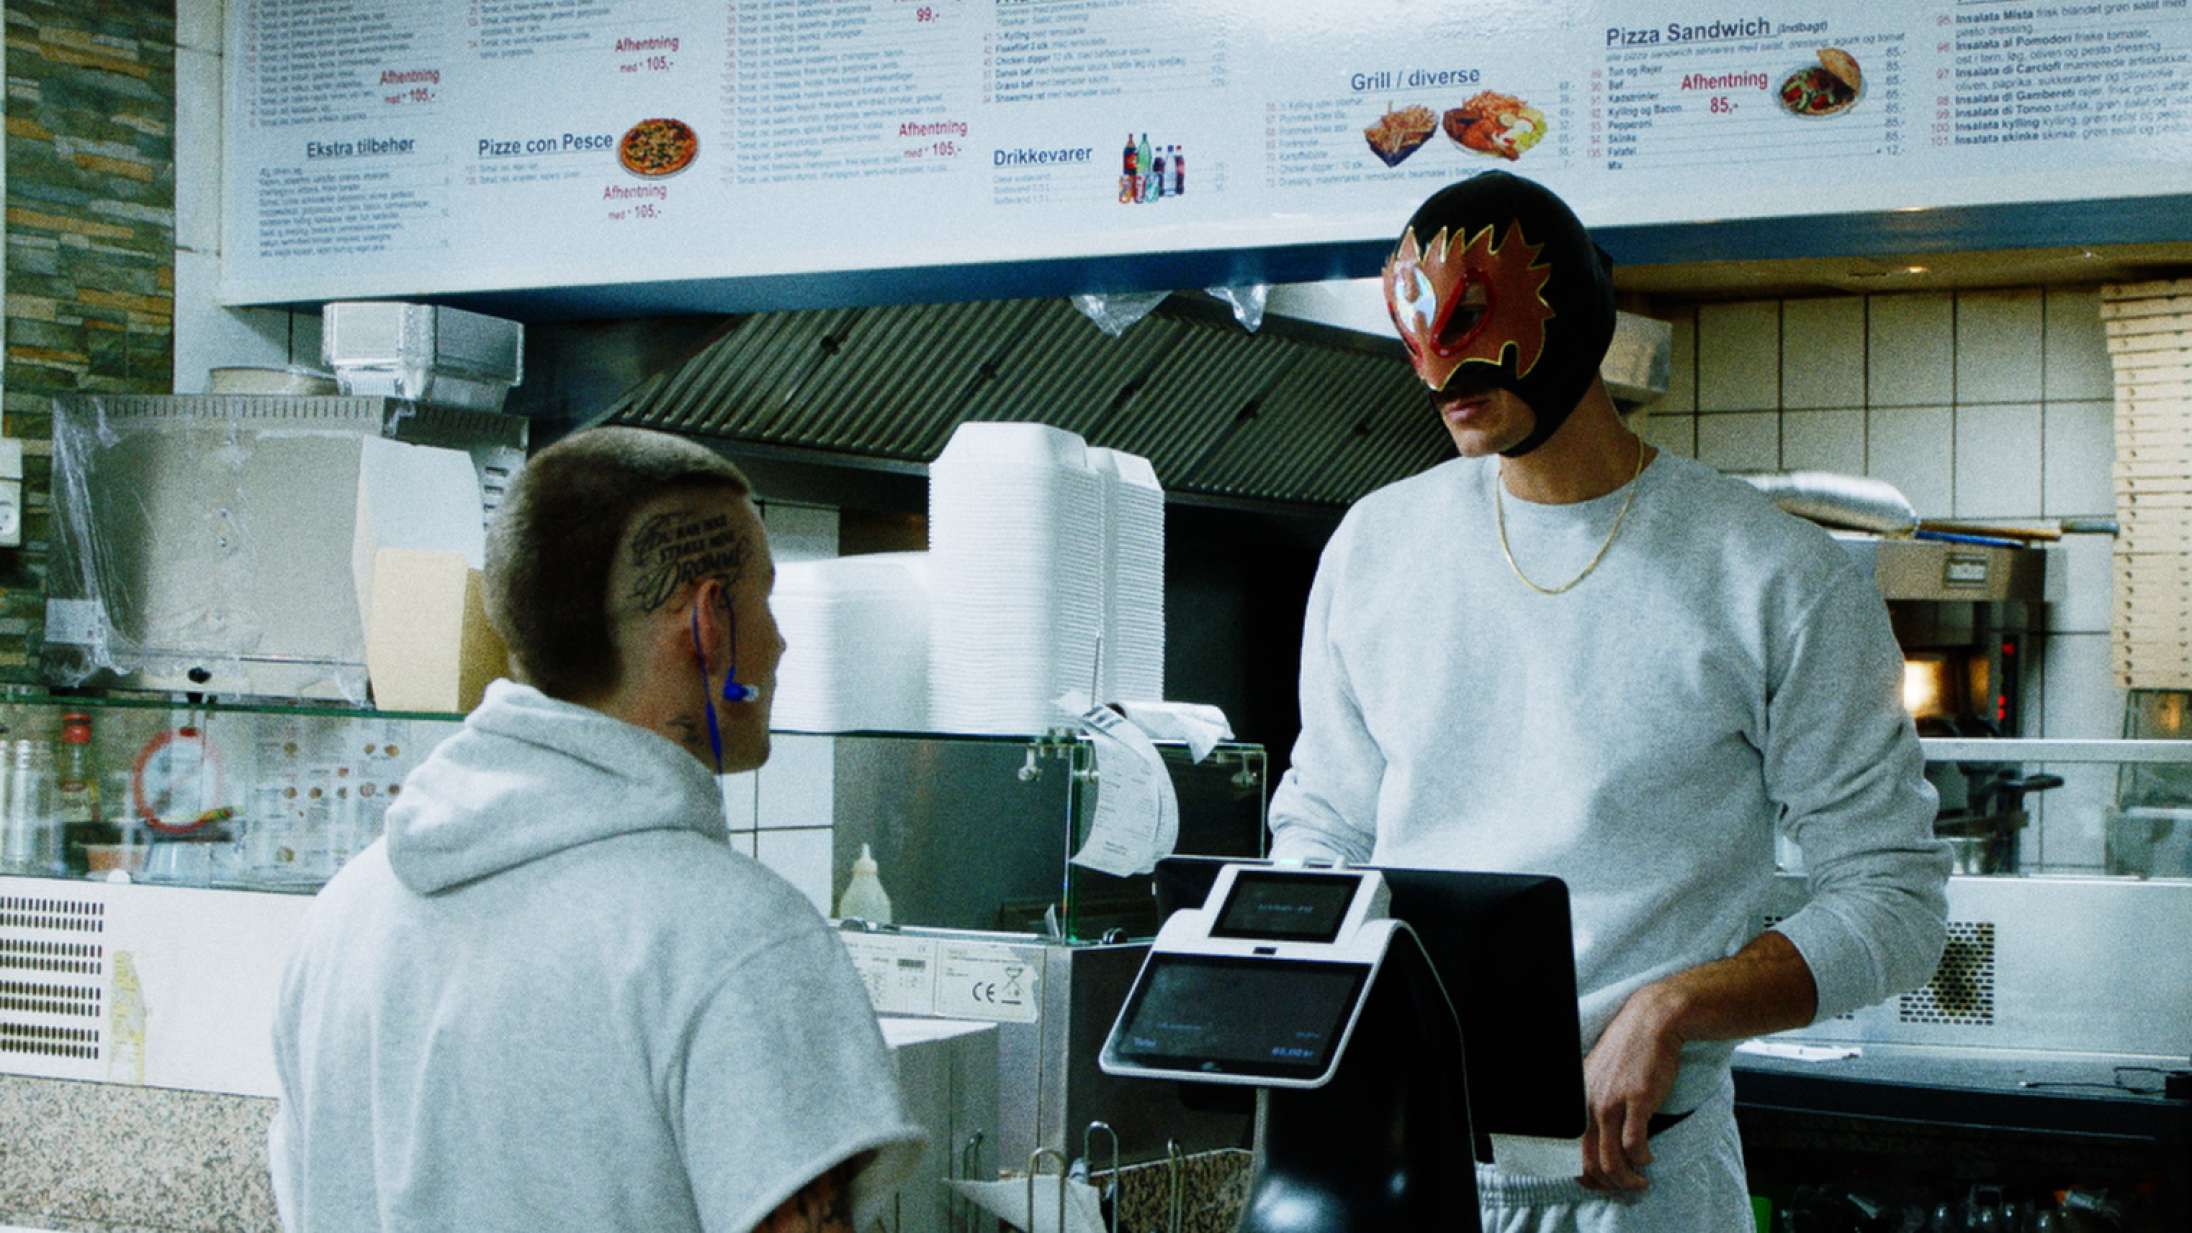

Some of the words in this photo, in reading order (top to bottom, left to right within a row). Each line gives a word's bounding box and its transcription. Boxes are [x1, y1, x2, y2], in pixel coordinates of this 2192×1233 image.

[917, 6, 940, 22] 99,-
[1955, 13, 2000, 24] Insalata
[2003, 9, 2034, 21] Mista
[1606, 28, 1660, 47] Pizza
[1667, 16, 1770, 42] Sandwich
[615, 36, 680, 53] Afhentning
[1955, 39, 2000, 51] Insalata
[2016, 34, 2073, 47] Pomodori
[646, 56, 674, 72] 105,-
[1955, 66, 2000, 78] Insalata
[380, 70, 440, 85] Afhentning
[1350, 72, 1391, 92] Grill
[1408, 67, 1481, 87] diverse
[1681, 69, 1768, 91] Afhentning
[1710, 95, 1739, 114] 85,-
[1955, 94, 2000, 105] Insalata
[1955, 107, 2000, 118] Insalata
[2016, 104, 2052, 115] Tonno
[899, 120, 968, 138] Afhentning
[1955, 121, 2000, 132] Insalata
[2002, 118, 2040, 131] kylling
[478, 138, 522, 157] Pizze
[526, 136, 557, 153] con
[562, 132, 614, 151] Pesce
[1955, 134, 2000, 145] Insalata
[2002, 131, 2039, 143] skinke
[306, 140, 354, 158] Ekstra
[357, 137, 415, 155] tilbehør
[933, 141, 962, 157] 105,-
[993, 146, 1093, 167] Drikkevarer
[602, 184, 667, 201] Afhentning
[972, 981, 995, 1004] CE
